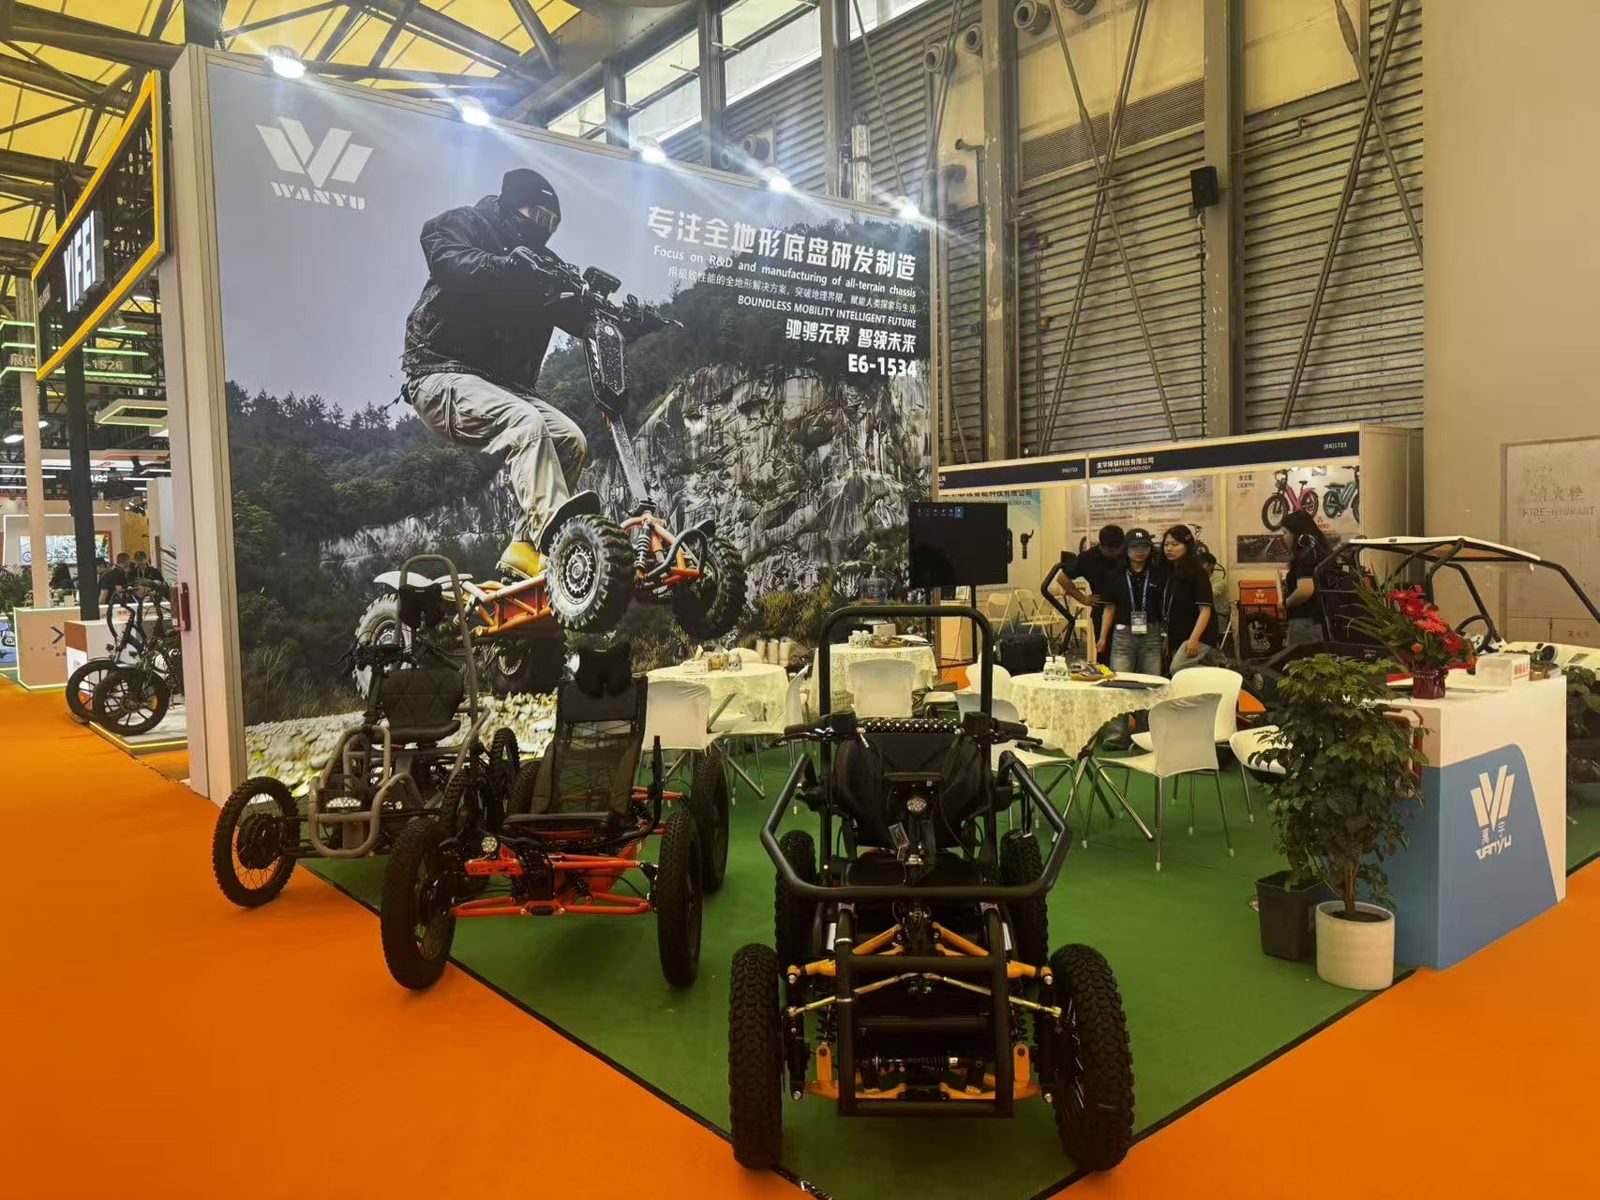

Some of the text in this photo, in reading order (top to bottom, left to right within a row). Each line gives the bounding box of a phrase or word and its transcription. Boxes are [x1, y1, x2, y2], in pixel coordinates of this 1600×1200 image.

[269, 181, 366, 210] WANYU
[647, 205, 916, 281] 专注全地形底盘研发制造
[653, 245, 917, 299] Focus on R&D and manufacturing of all-terrain chassis
[738, 295, 917, 329] BOUNDLESS MOBILITY INTELLIGENT FUTURE
[785, 318, 917, 354] 驰骋无界 智领未来
[848, 353, 918, 378] E6-1534
